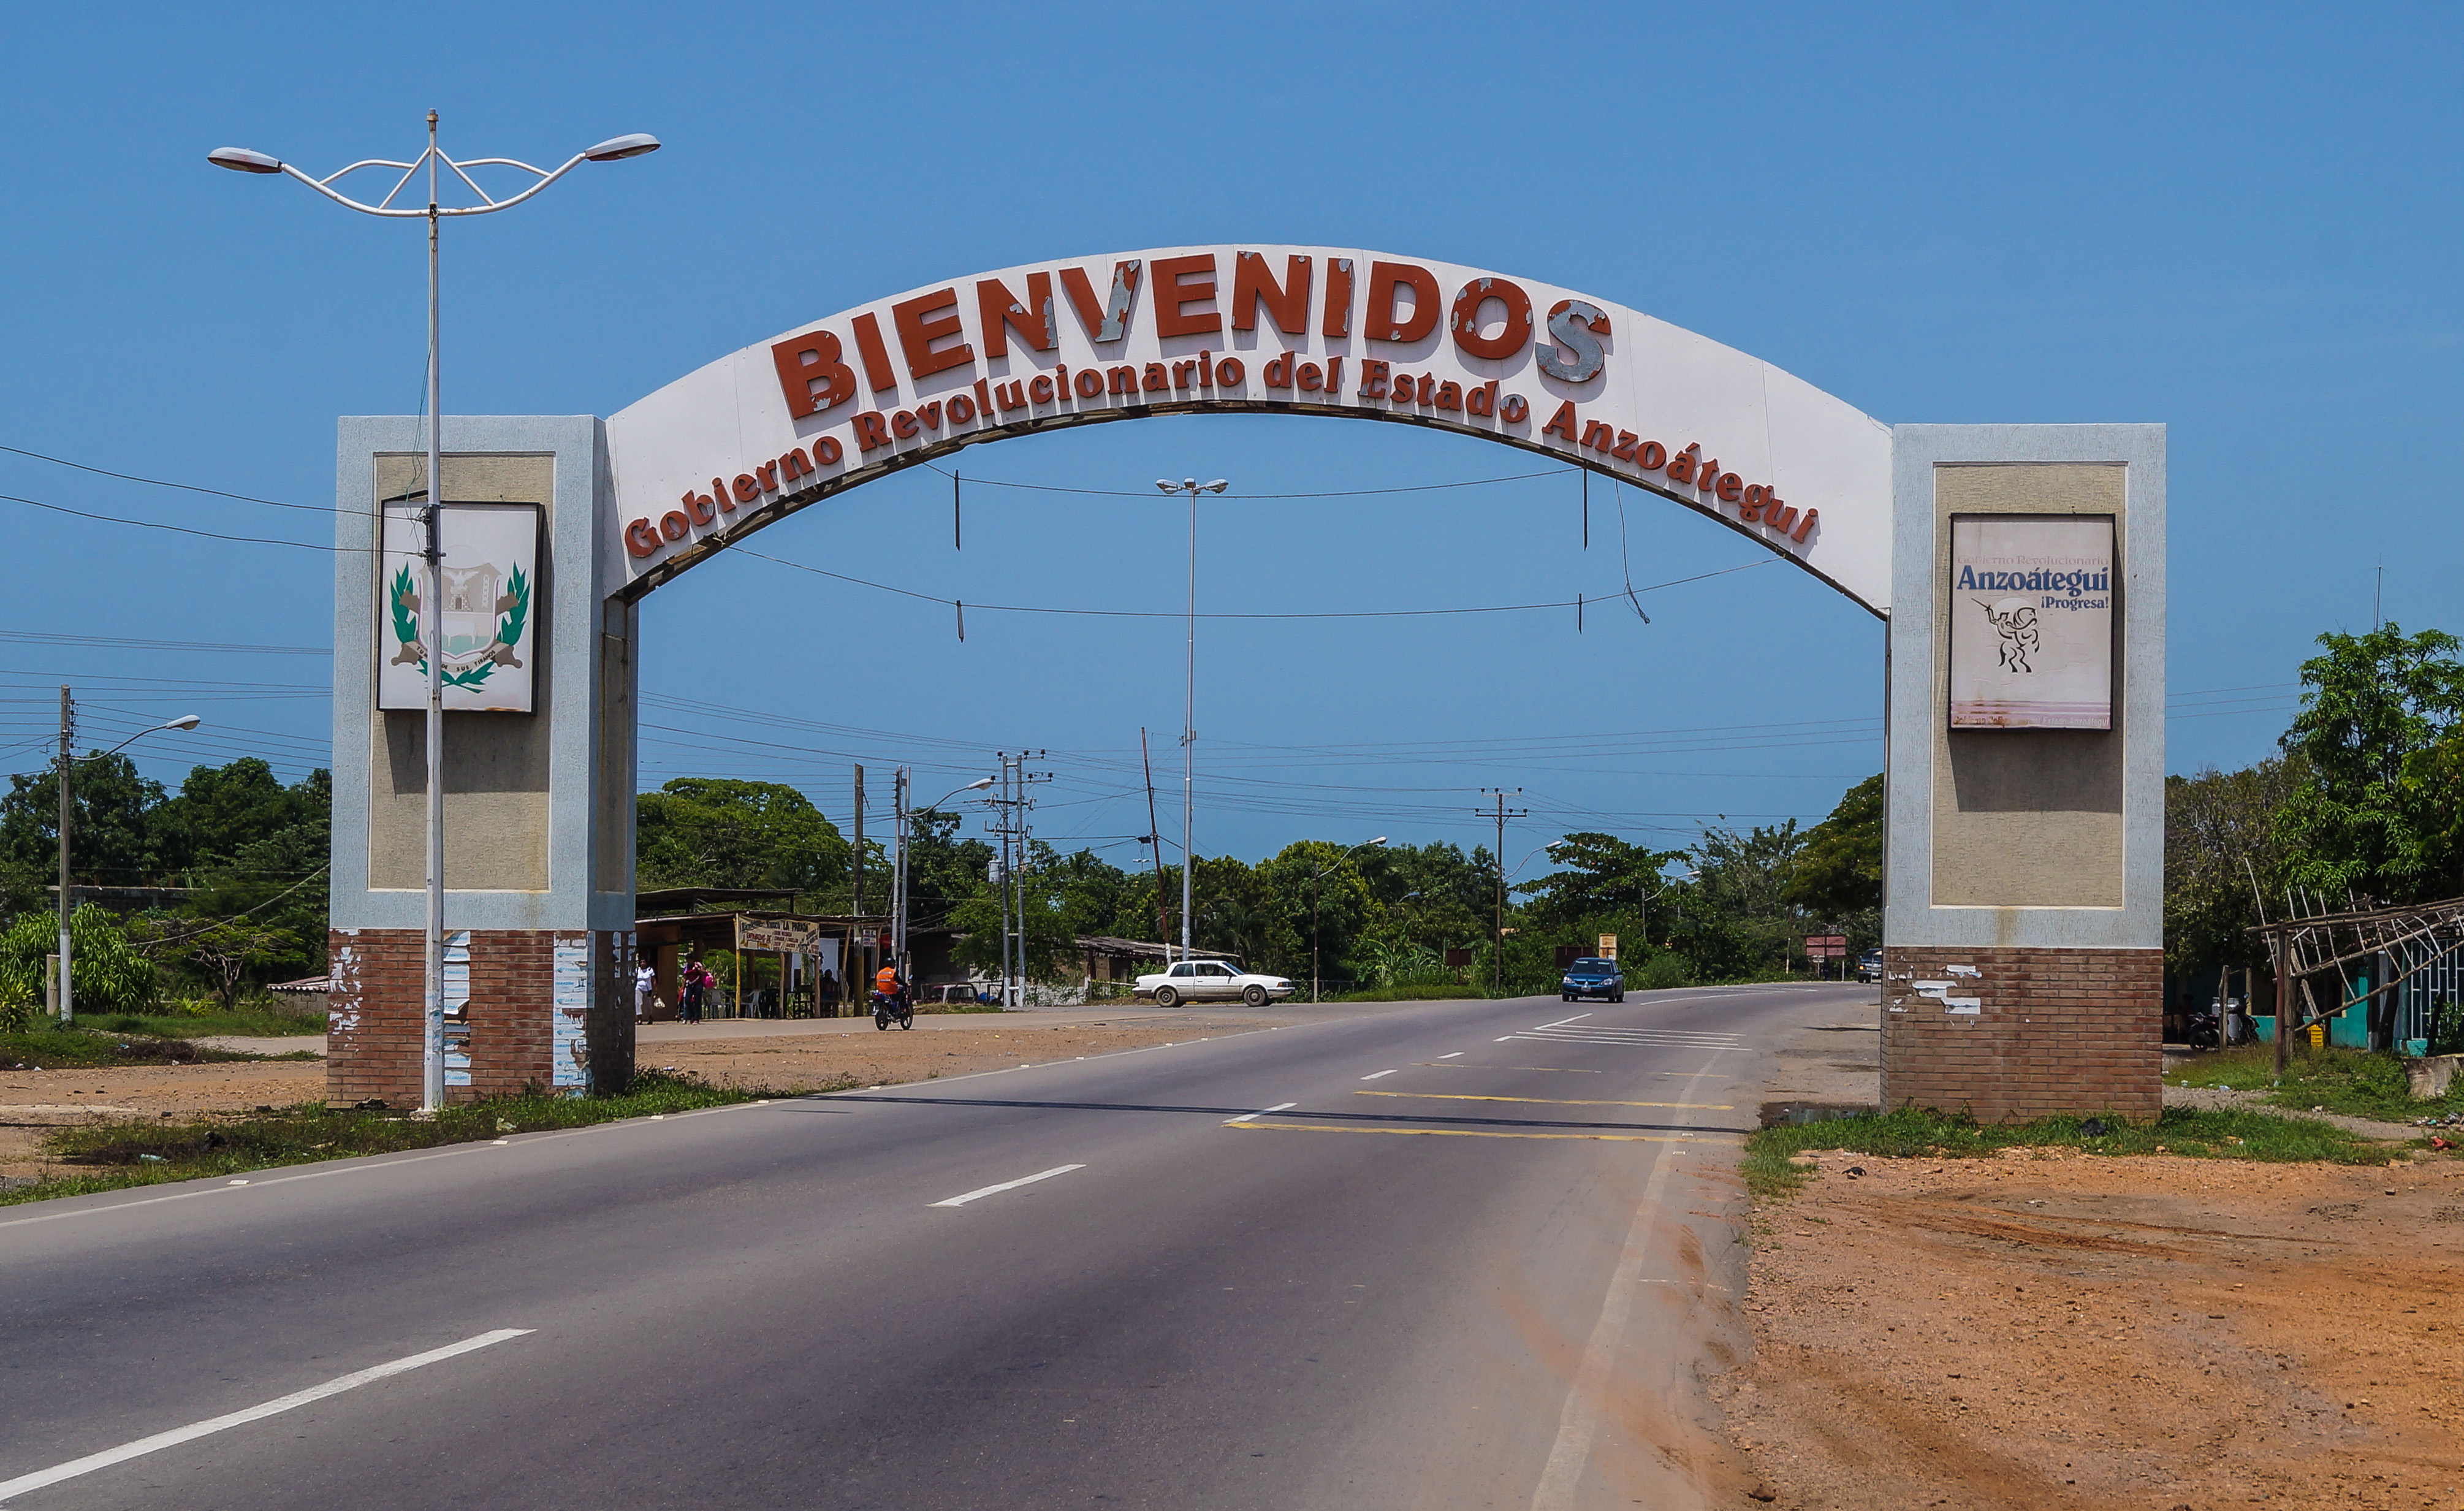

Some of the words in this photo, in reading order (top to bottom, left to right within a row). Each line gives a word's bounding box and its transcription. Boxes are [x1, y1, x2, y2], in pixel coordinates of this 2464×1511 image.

[770, 250, 1613, 421] BIENVENIDOS
[623, 435, 843, 558] Gobierno
[850, 349, 1245, 454] Revolucionario
[1262, 350, 1344, 394] del
[1356, 358, 1530, 424] Estado
[1541, 399, 1819, 545] Anzoátegui
[1956, 564, 2109, 597] Anzoátegui
[2041, 596, 2108, 612] ¡Progresa!
[474, 649, 496, 666] TIRANOS
